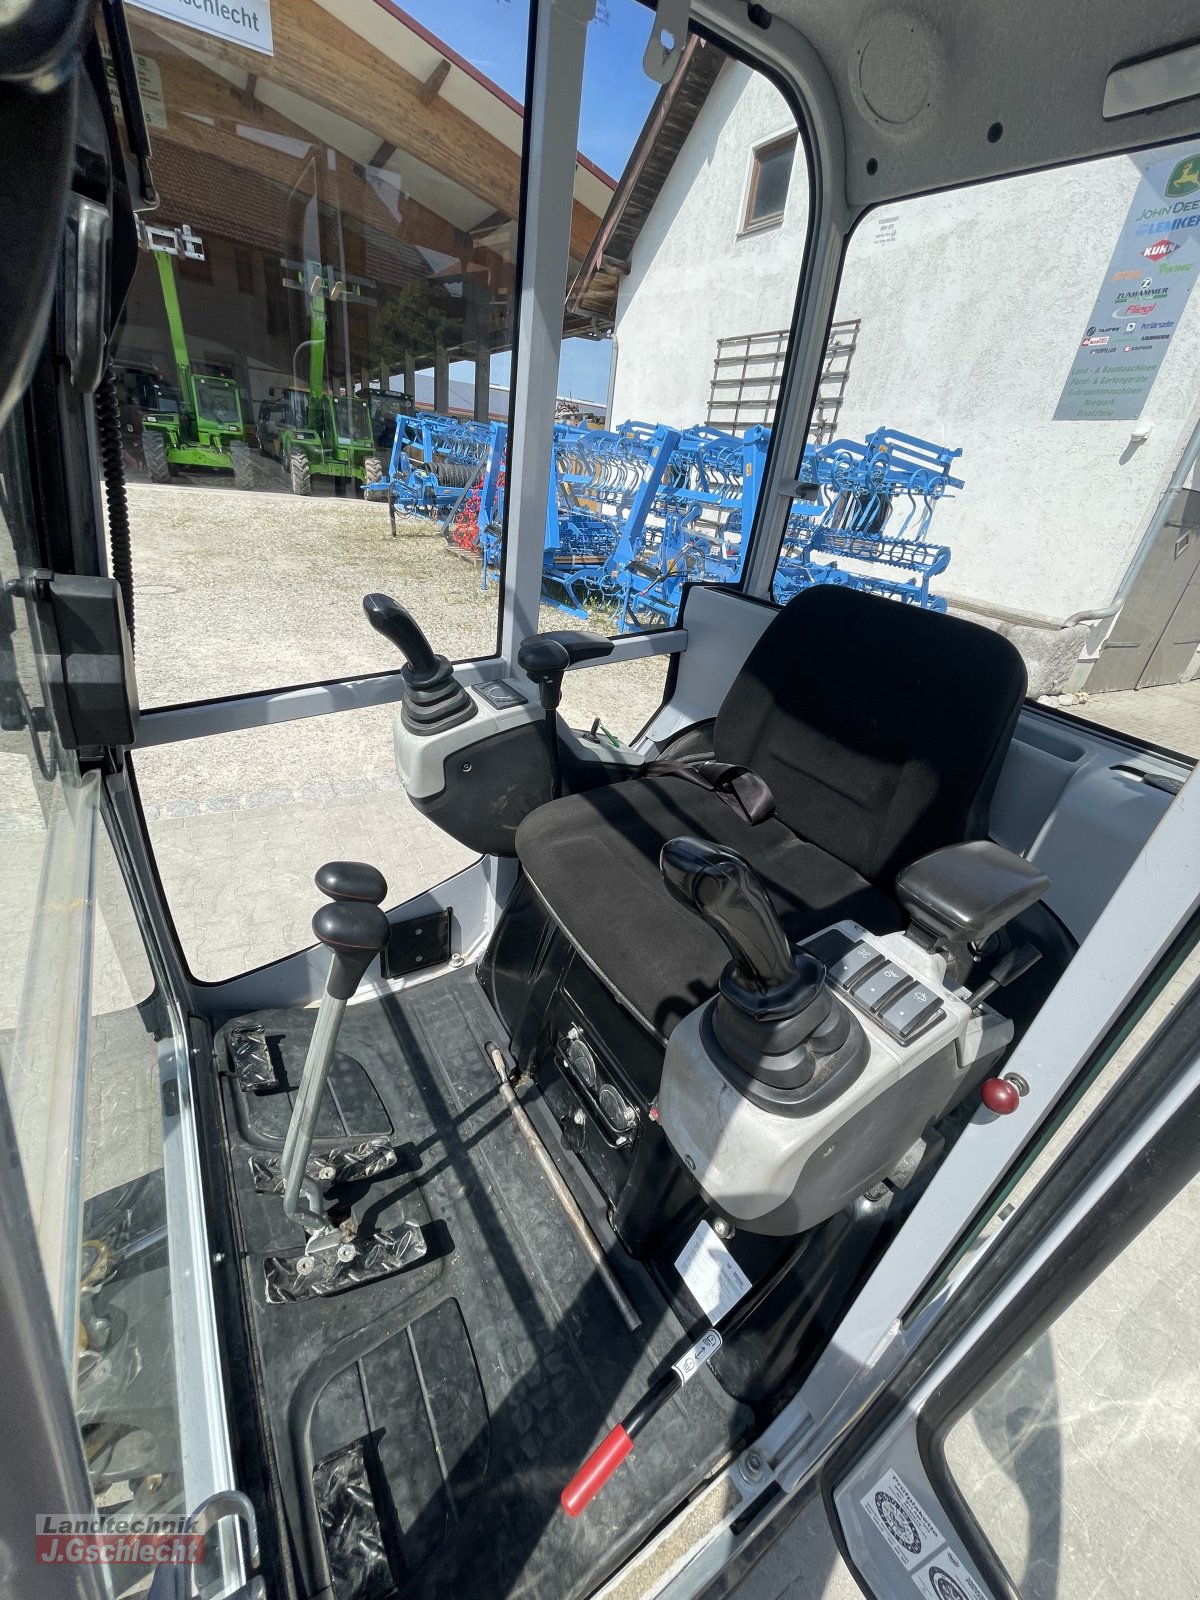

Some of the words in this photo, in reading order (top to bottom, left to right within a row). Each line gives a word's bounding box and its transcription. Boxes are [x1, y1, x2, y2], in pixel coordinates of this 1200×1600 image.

[1136, 206, 1172, 221] JOHN
[1173, 200, 1200, 213] DEE
[1143, 243, 1177, 257] KUHN
[1117, 287, 1168, 299] ZUNHAMMER
[1125, 303, 1157, 315] Fliegl
